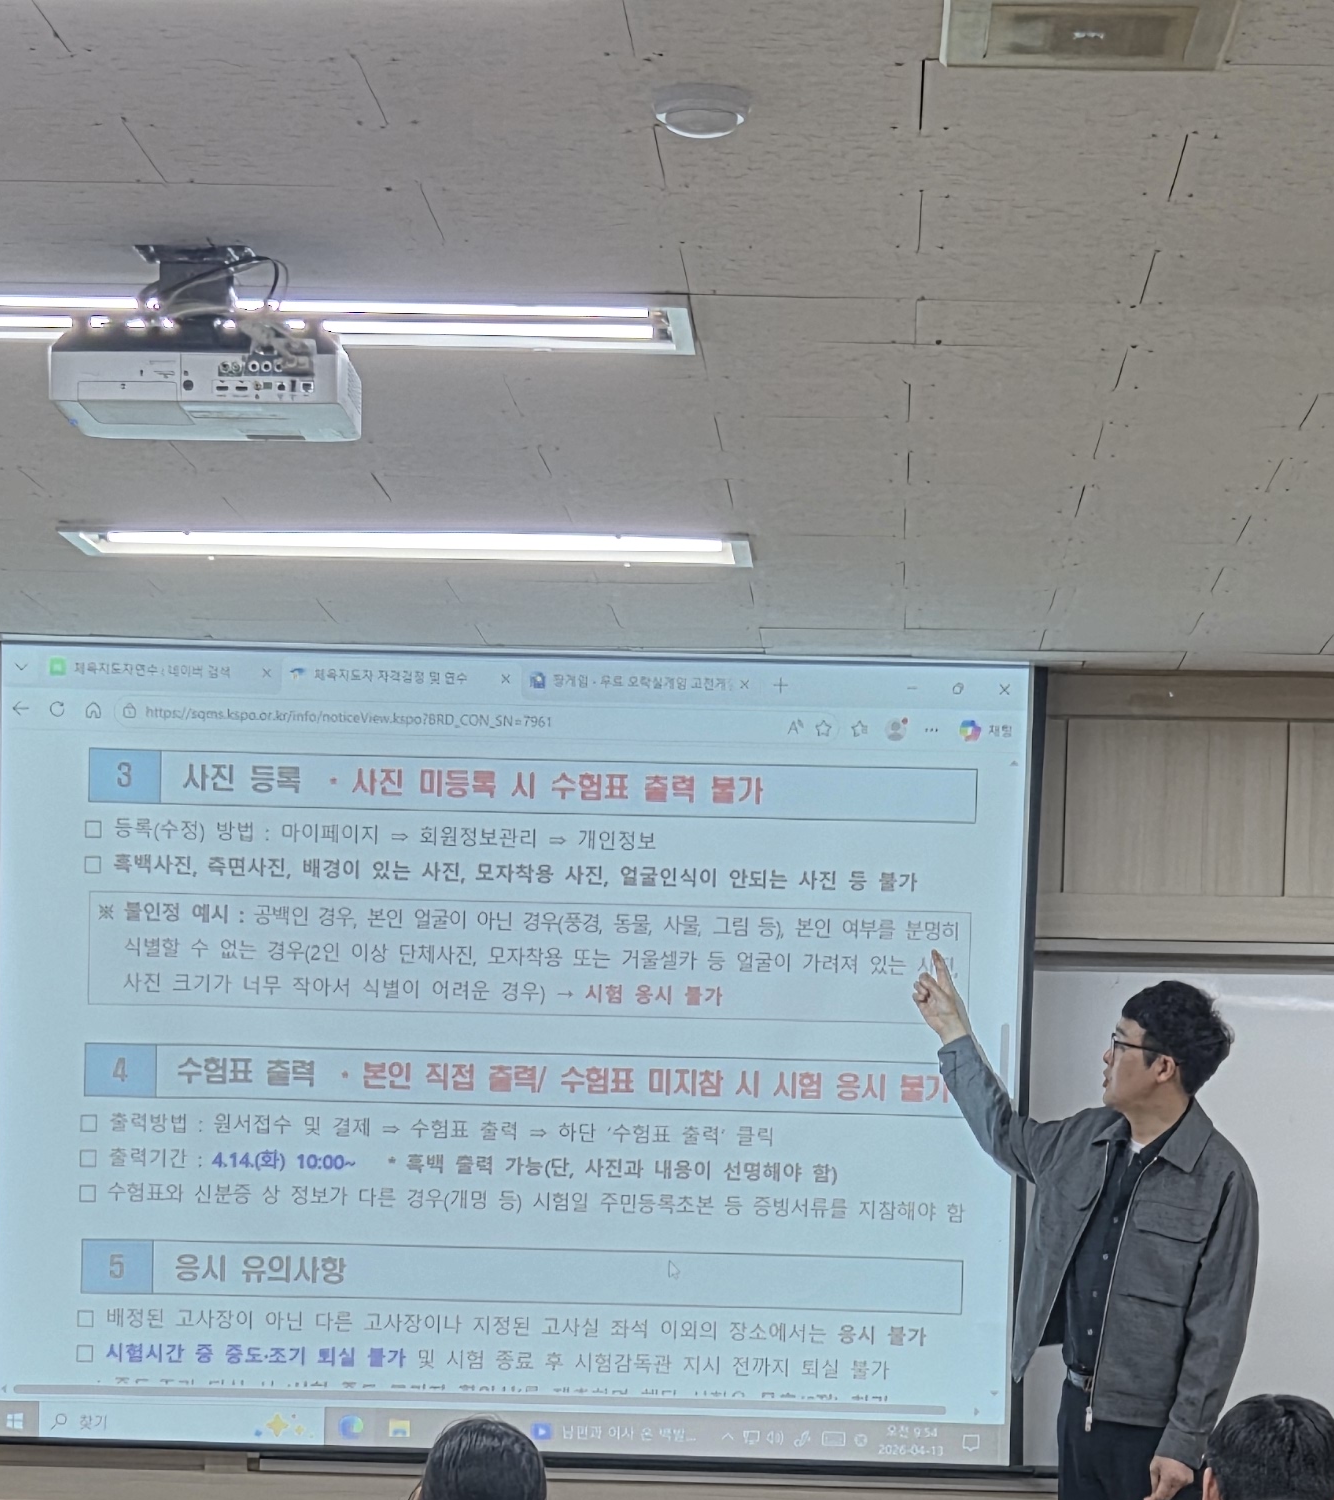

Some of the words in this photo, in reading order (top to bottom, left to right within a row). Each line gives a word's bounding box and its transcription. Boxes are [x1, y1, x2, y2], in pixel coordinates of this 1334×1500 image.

[117, 762, 133, 788] 3
[183, 763, 234, 792] 사진
[251, 765, 300, 794] 등록
[352, 768, 402, 796] 사진
[420, 769, 496, 798] 미등록
[511, 772, 535, 799] 시
[552, 772, 633, 801] 수험표
[645, 775, 694, 803] 출력
[711, 776, 763, 805] 불가
[115, 818, 204, 843] 등록(수정)
[217, 821, 253, 842] 방법
[282, 823, 378, 845] 마이페이지
[420, 826, 536, 849] 회원정보관리
[579, 830, 656, 851] 개인정보
[114, 854, 197, 877] 흑백사진,
[208, 856, 291, 879] 측면사진,
[303, 858, 359, 879] 배경이
[373, 860, 411, 881] 있는
[422, 861, 465, 884] 사진,
[475, 863, 554, 884] 모자착용
[565, 865, 609, 887] 사진,
[621, 866, 716, 888] 얼굴인식이
[729, 869, 788, 889] 안되는
[799, 870, 836, 891] 사진
[879, 872, 918, 892] 불가
[124, 901, 179, 922] 불인정
[192, 903, 228, 924] 예시
[254, 905, 308, 926] 공백인
[319, 907, 357, 929] 경우,
[367, 908, 402, 929] 본인
[414, 909, 466, 930] 얼굴이
[477, 911, 511, 931] 아닌
[524, 912, 602, 935] 경우(풍경,
[614, 913, 652, 936] 동물,
[664, 915, 701, 937] 사물,
[713, 917, 748, 937] 그림
[758, 917, 784, 940] 등),
[795, 918, 831, 938] 본인
[843, 919, 895, 940] 여부를
[905, 920, 958, 941] 분명히
[125, 937, 180, 957] 식별할
[221, 939, 256, 959] 없는
[268, 941, 339, 964] 경우(2인
[352, 943, 389, 963] 이상
[400, 944, 476, 967] 단체사진,
[488, 947, 563, 967] 모자착용
[573, 949, 611, 969] 또는
[622, 950, 698, 970] 거울셀카
[737, 952, 790, 972] 얼굴이
[803, 953, 857, 974] 가려져
[871, 955, 906, 975] 있는
[123, 972, 160, 993] 사진
[172, 974, 232, 994] 크기가
[244, 975, 281, 995] 너무
[293, 976, 349, 997] 작아서
[363, 978, 419, 999] 식별이
[432, 980, 490, 1001] 어려운
[502, 982, 545, 1005] 경우)
[585, 984, 622, 1004] 시험
[635, 985, 672, 1005] 응시
[685, 986, 723, 1006] 불가
[112, 1057, 128, 1082] 4
[177, 1057, 253, 1085] 수험표
[267, 1059, 315, 1087] 출력
[363, 1062, 411, 1090] 본인
[425, 1063, 474, 1091] 직접
[489, 1065, 547, 1093] 출력/
[561, 1066, 638, 1094] 수험표
[648, 1067, 724, 1098] 미지참
[735, 1071, 759, 1098] 시
[773, 1071, 823, 1100] 시험
[836, 1073, 886, 1102] 응시
[110, 1113, 186, 1133] 출력방법
[214, 1113, 291, 1135] 원서접수
[333, 1117, 370, 1137] 결제
[410, 1118, 468, 1139] 수험표
[480, 1120, 516, 1141] 출력
[559, 1122, 596, 1143] 하단
[737, 1126, 773, 1147] 클릭
[110, 1147, 187, 1168] 출력기간
[406, 1154, 443, 1174] 흑백
[456, 1155, 492, 1175] 출력
[505, 1156, 574, 1179] 가능(단,
[585, 1158, 644, 1179] 사진과
[655, 1160, 710, 1181] 내용이
[724, 1161, 802, 1183] 선명해야
[813, 1164, 837, 1186] 함)
[107, 1182, 184, 1203] 수험표와
[195, 1184, 251, 1204] 신분증
[291, 1185, 348, 1206] 정보가
[359, 1187, 396, 1208] 다른
[407, 1189, 486, 1212] 경우(개명
[499, 1190, 521, 1214] 등)
[533, 1192, 587, 1212] 시험일
[601, 1193, 714, 1215] 주민등록초본
[753, 1196, 848, 1219] 증빙서류를
[859, 1200, 936, 1222] 지참해야
[109, 1254, 125, 1280] 5
[175, 1254, 225, 1282] 응시
[241, 1255, 347, 1285] 유의사항
[107, 1308, 163, 1328] 배정된
[175, 1309, 253, 1330] 고사장이
[265, 1311, 302, 1331] 아닌
[316, 1311, 352, 1332] 다른
[364, 1313, 462, 1334] 고사장이나
[473, 1316, 529, 1336] 지정된
[541, 1318, 598, 1338] 고사실
[611, 1318, 647, 1339] 좌석
[661, 1320, 716, 1341] 이외의
[730, 1321, 826, 1344] 장소에서는
[837, 1325, 875, 1345] 응시
[888, 1326, 927, 1347] 불가
[106, 1343, 186, 1363] 시험시간
[317, 1347, 355, 1367] 퇴실
[368, 1348, 406, 1368] 불가
[447, 1350, 483, 1369] 시험
[495, 1350, 534, 1371] 종료
[575, 1352, 672, 1374] 시험감독관
[684, 1355, 719, 1375] 지시
[733, 1357, 788, 1377] 전까지
[801, 1358, 838, 1379] 퇴실
[851, 1360, 890, 1380] 불가
[79, 1414, 108, 1431] 찾기
